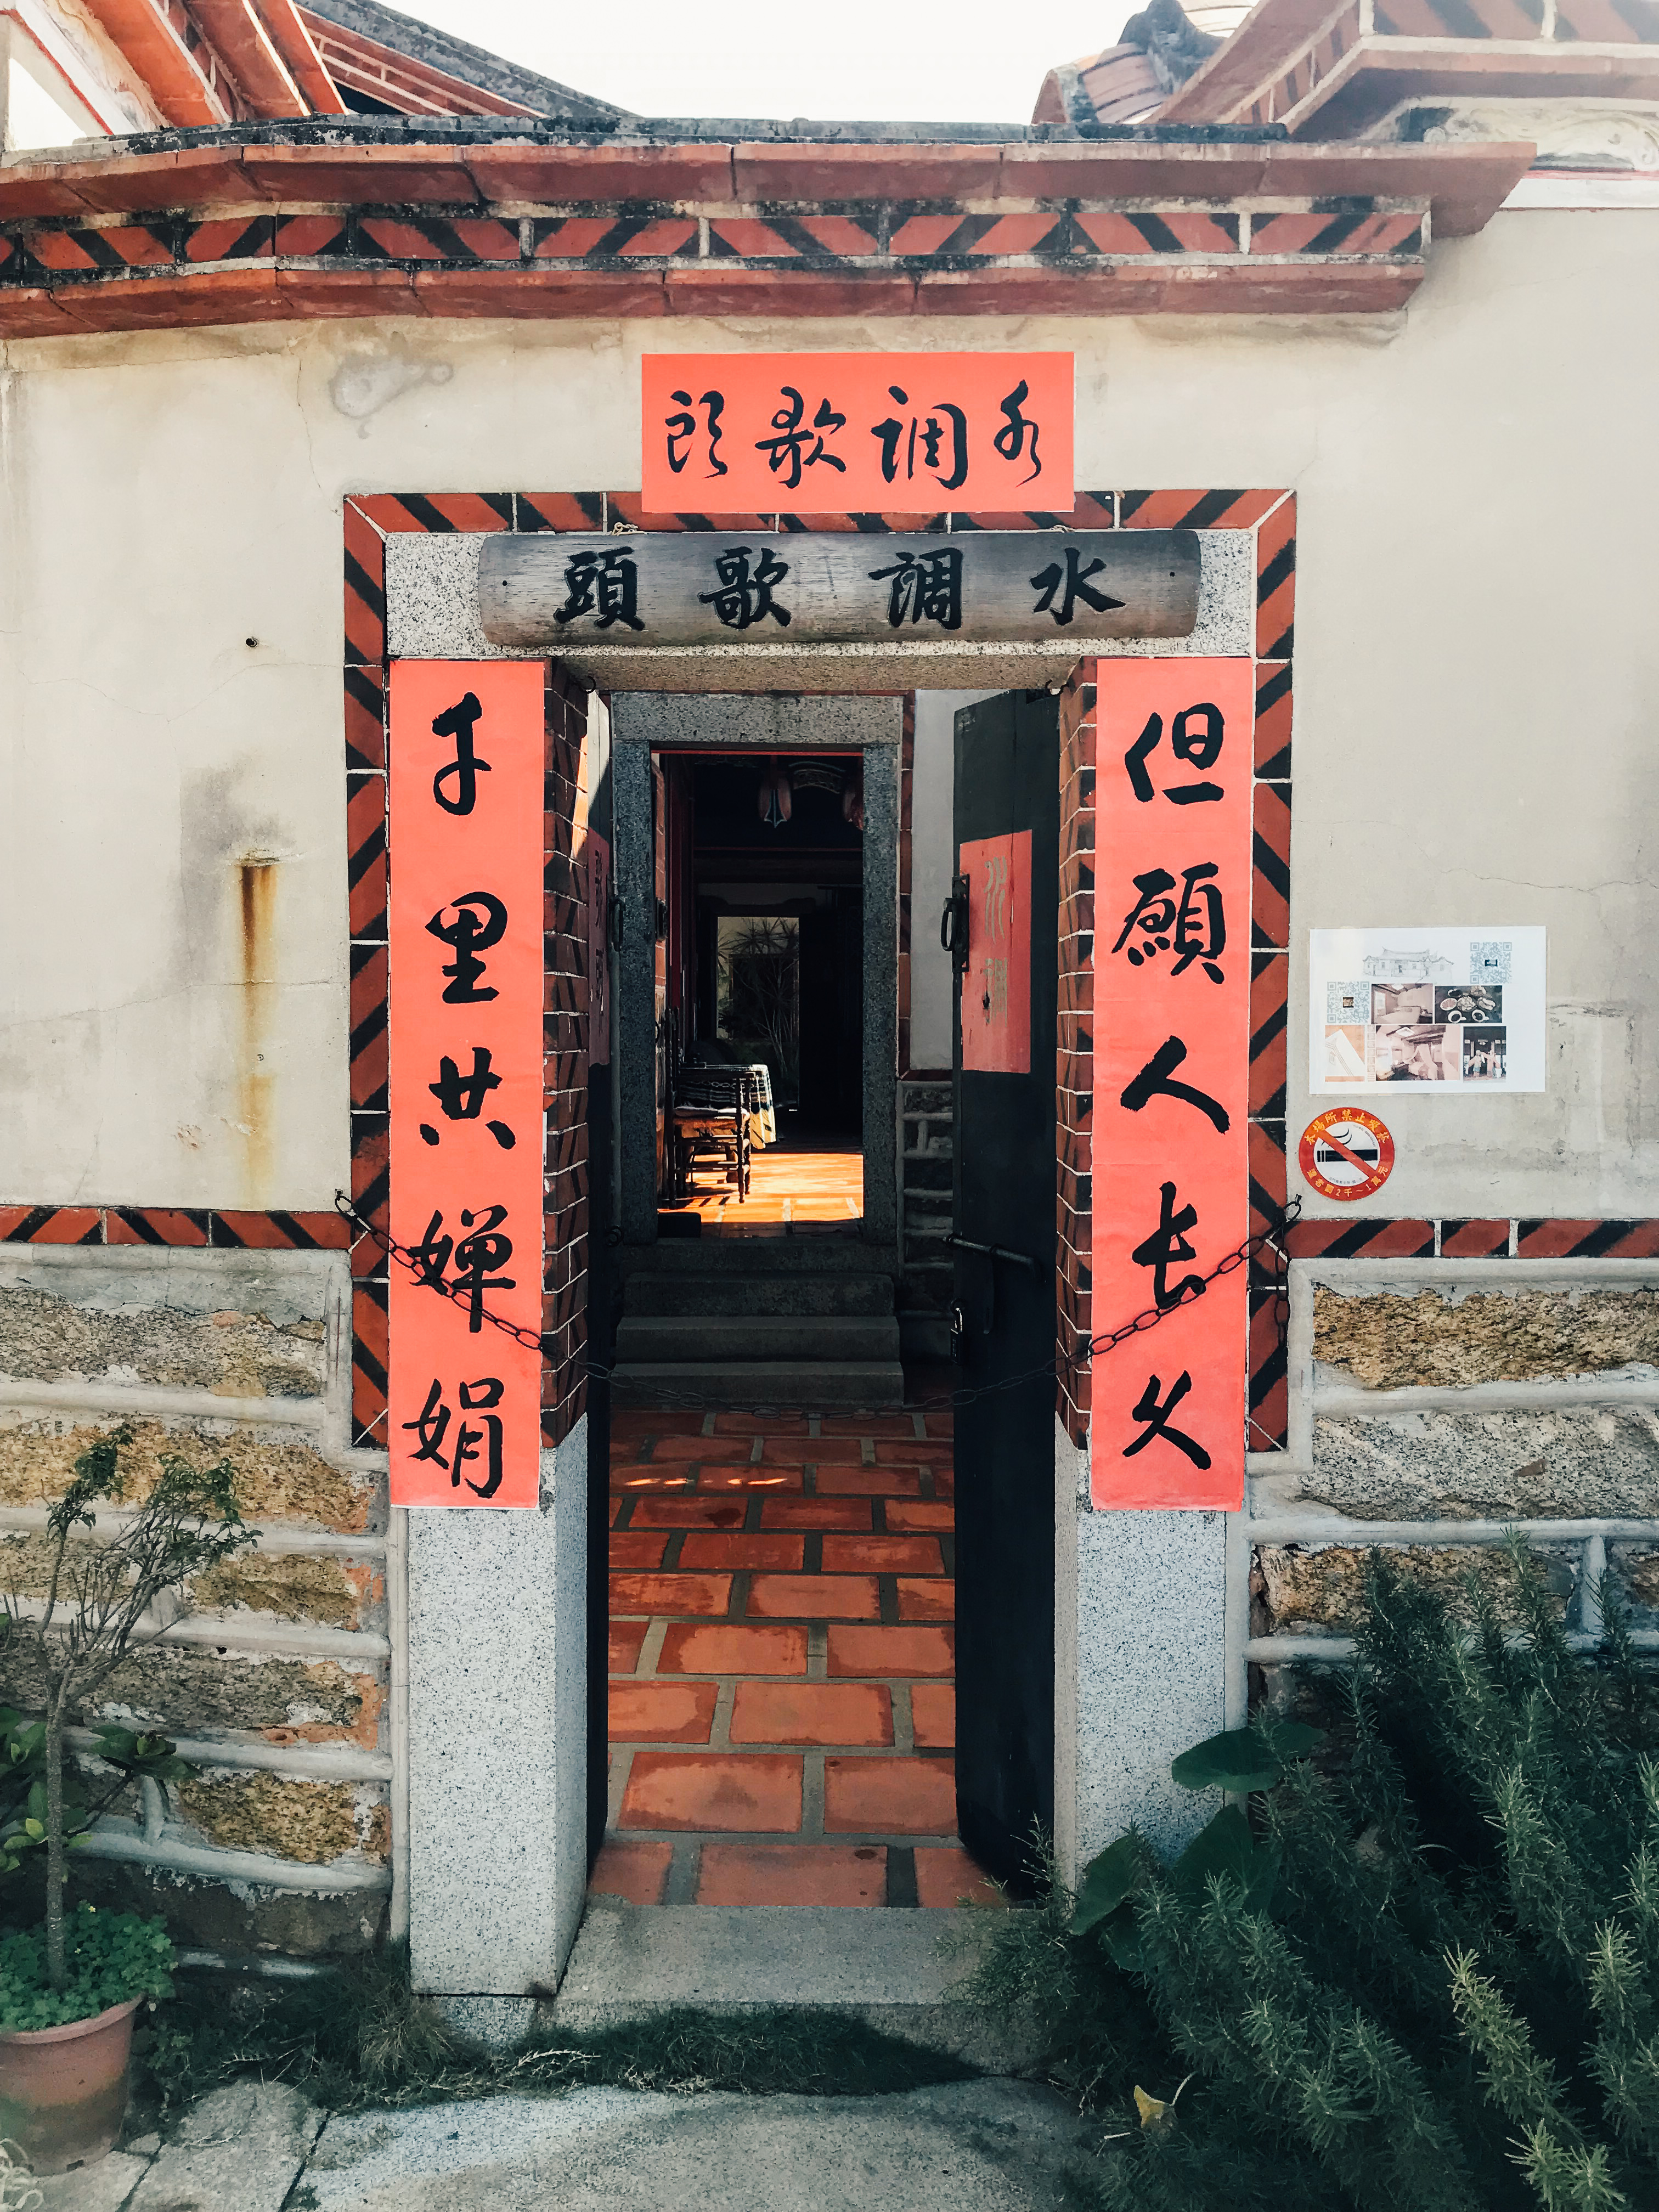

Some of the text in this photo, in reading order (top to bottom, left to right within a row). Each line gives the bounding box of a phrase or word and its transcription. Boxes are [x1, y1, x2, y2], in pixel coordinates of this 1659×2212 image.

[553, 546, 1126, 631] 水調歌頭
[1111, 703, 1230, 1470] 但願人長久
